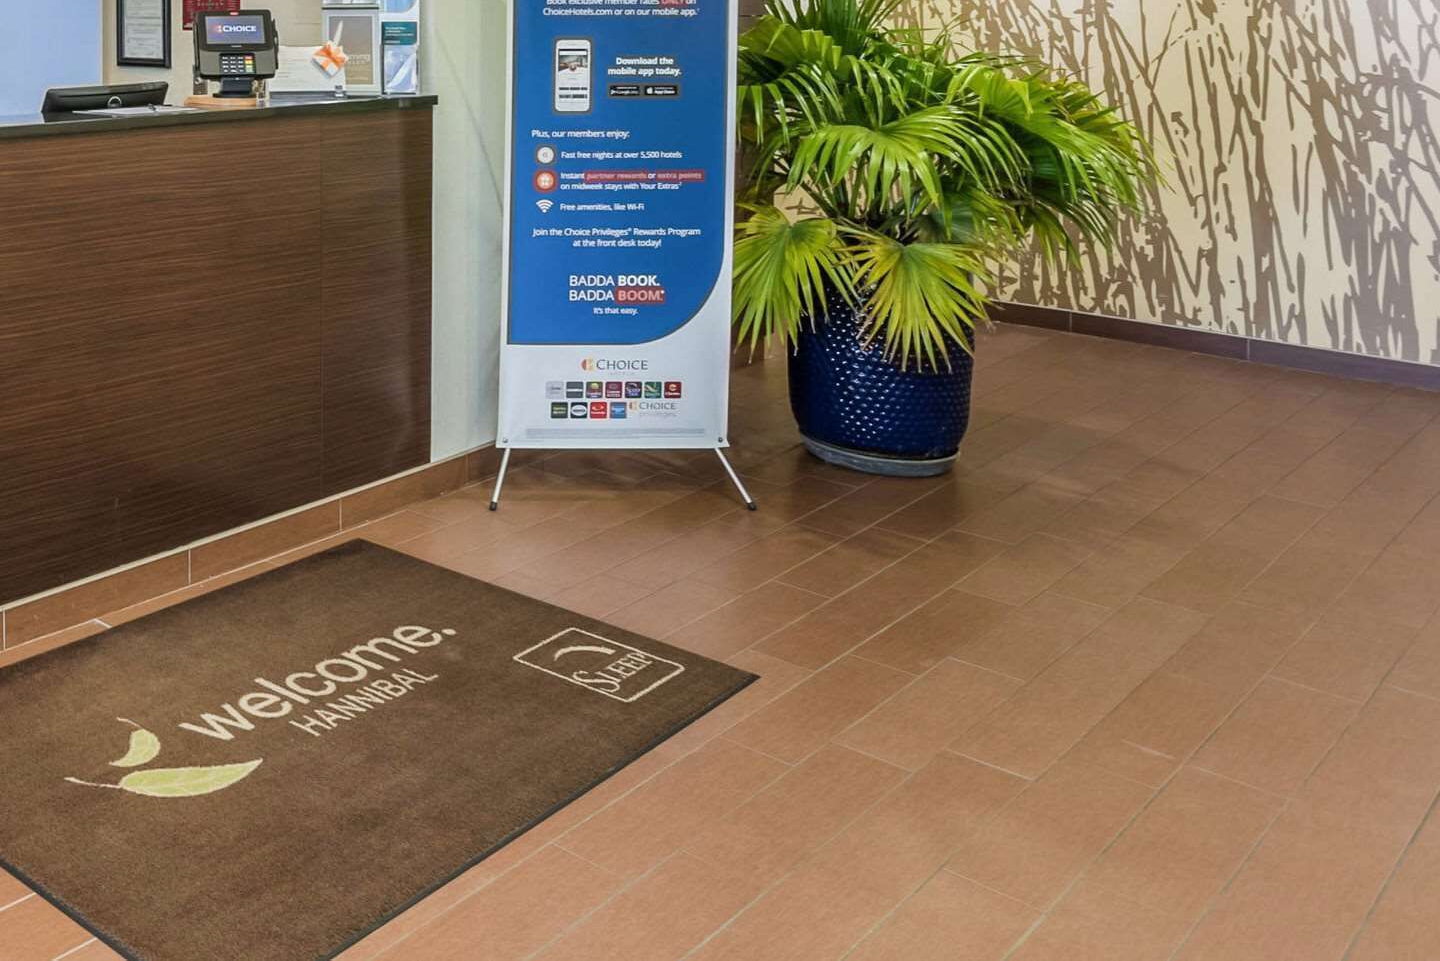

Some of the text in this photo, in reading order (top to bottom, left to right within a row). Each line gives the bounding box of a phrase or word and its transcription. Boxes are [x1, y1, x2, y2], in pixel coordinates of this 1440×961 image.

[542, 7, 613, 16] ChoiceHotels.com
[652, 7, 679, 16] mobile
[616, 57, 674, 65] Download the
[608, 67, 682, 77] mobile app today.
[531, 129, 550, 138] Plus,
[567, 129, 605, 138] members
[606, 130, 630, 140] enjoy:
[561, 151, 576, 159] Fast
[577, 151, 591, 159] free
[592, 151, 614, 160] nights
[661, 151, 682, 159] hotels
[586, 173, 615, 181] partner
[678, 173, 702, 181] points
[605, 183, 622, 191] stays
[560, 203, 576, 211] Free
[577, 203, 612, 211] amenities,
[532, 228, 549, 237] Join
[549, 228, 563, 236] the
[564, 228, 590, 236] Choice
[633, 228, 666, 236] Rewards
[667, 228, 701, 237] Program
[582, 239, 596, 247] the
[597, 239, 616, 247] front
[618, 239, 636, 247] desk
[637, 239, 662, 248] today!
[569, 275, 660, 286] BADDA BOOK.
[569, 290, 615, 301] BADDA
[596, 359, 649, 370] CHOICE
[639, 402, 677, 410] CHOICE
[572, 652, 653, 693] SLEEP
[178, 625, 457, 740] welcome.
[289, 668, 439, 737] HANNIBAL
